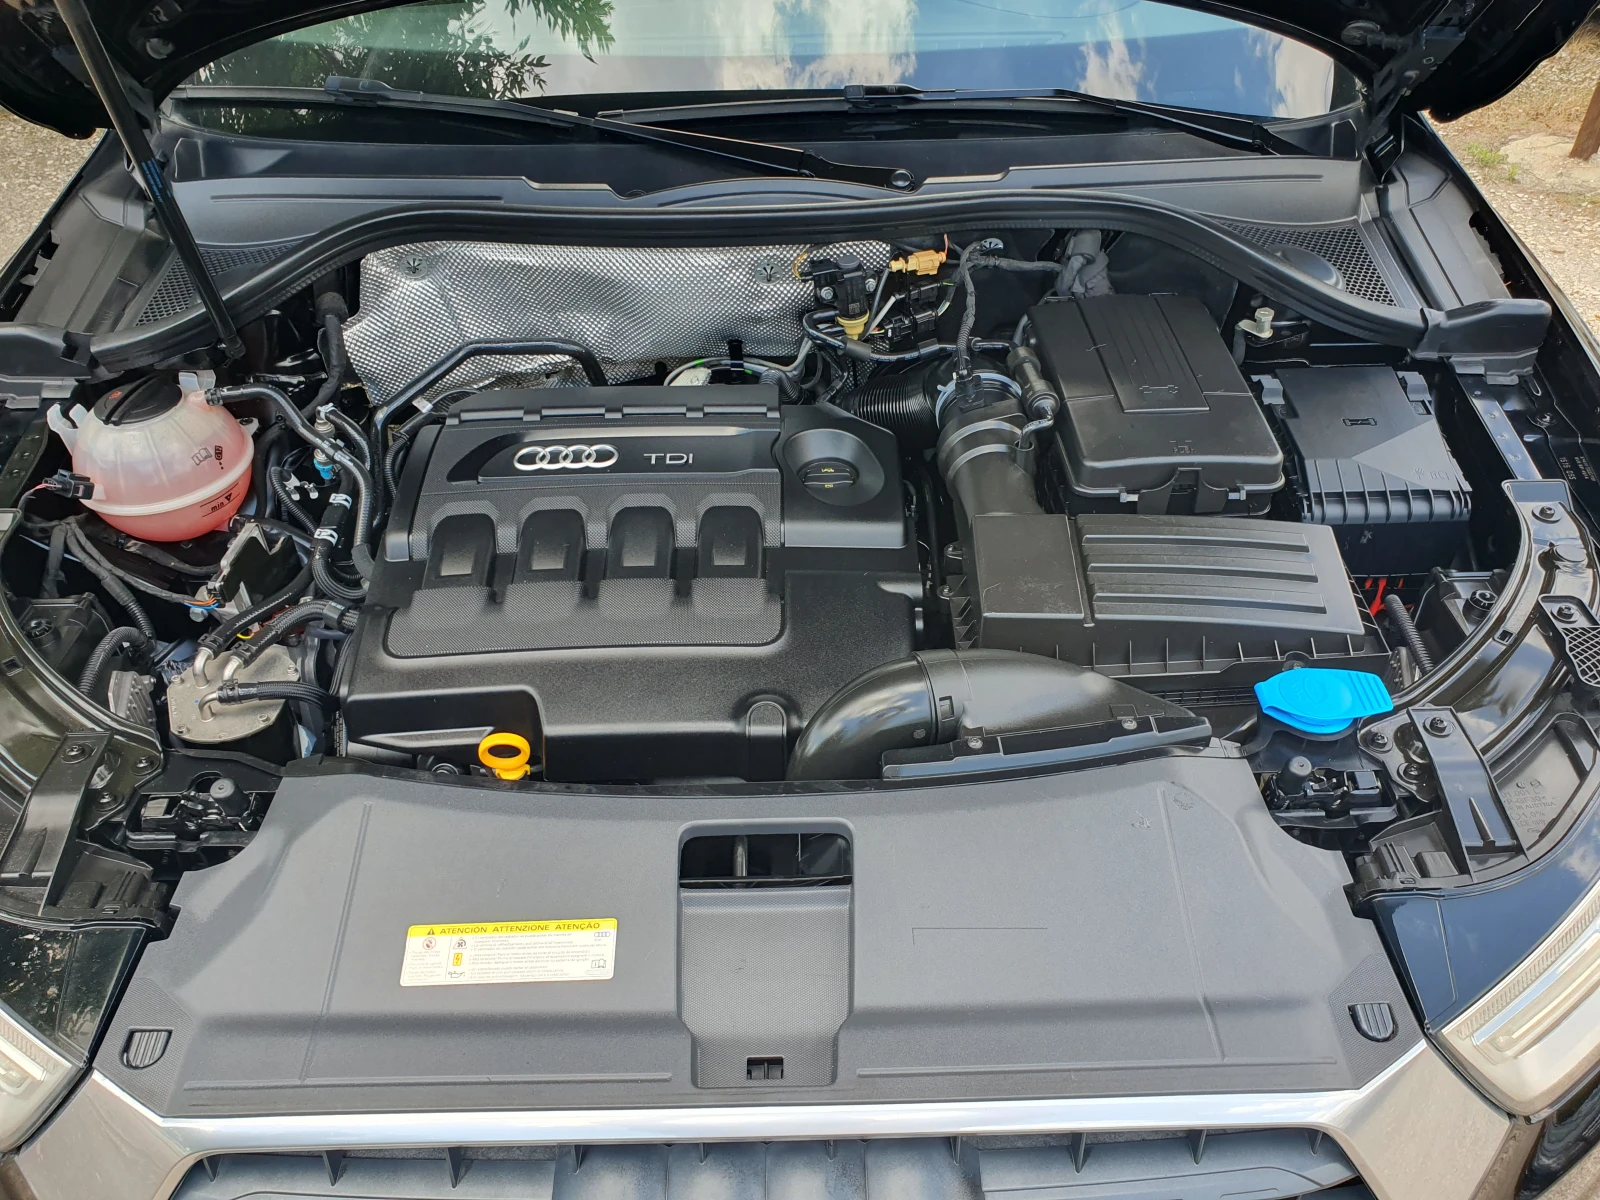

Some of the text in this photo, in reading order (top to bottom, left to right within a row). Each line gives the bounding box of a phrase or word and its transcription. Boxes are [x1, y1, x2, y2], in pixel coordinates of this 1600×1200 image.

[643, 453, 693, 464] TDI
[211, 501, 225, 512] min
[439, 922, 600, 935] ATENCIÓN ATTENZIONE ATENÇÃO
